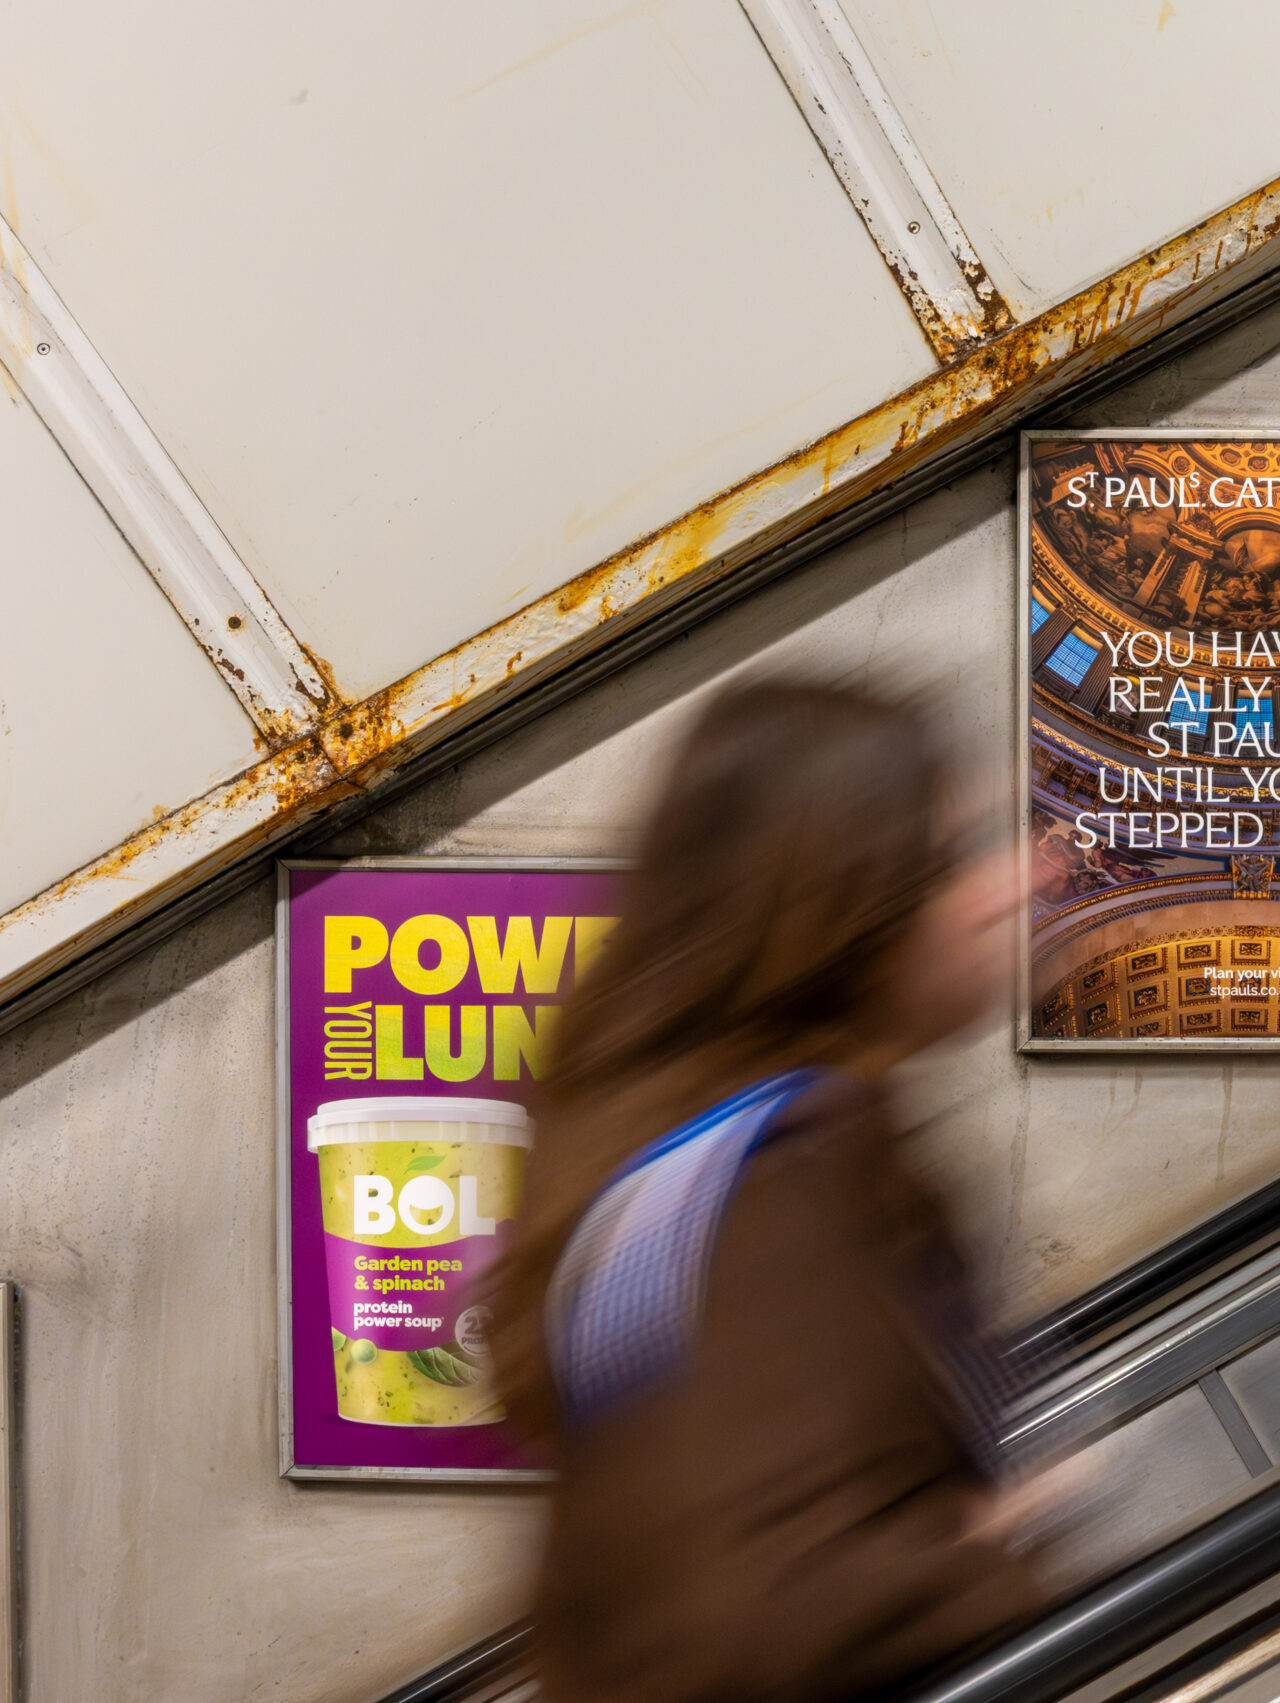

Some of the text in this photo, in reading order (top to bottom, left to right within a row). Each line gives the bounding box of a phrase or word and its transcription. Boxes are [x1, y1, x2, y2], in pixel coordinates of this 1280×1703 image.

[1101, 631, 1194, 667] YOU
[1109, 676, 1272, 713] REALLY
[1147, 721, 1200, 758] ST
[1099, 767, 1230, 803] UNTIL
[1074, 811, 1264, 849] STEPPED
[1204, 967, 1234, 979] Plan
[1237, 969, 1268, 982] your
[324, 1001, 372, 1081] YOUR
[353, 1175, 496, 1236] BOL
[354, 1256, 462, 1275] Garden pea
[354, 1275, 445, 1294] & spinach
[353, 1301, 412, 1316] protein
[353, 1317, 402, 1331] power
